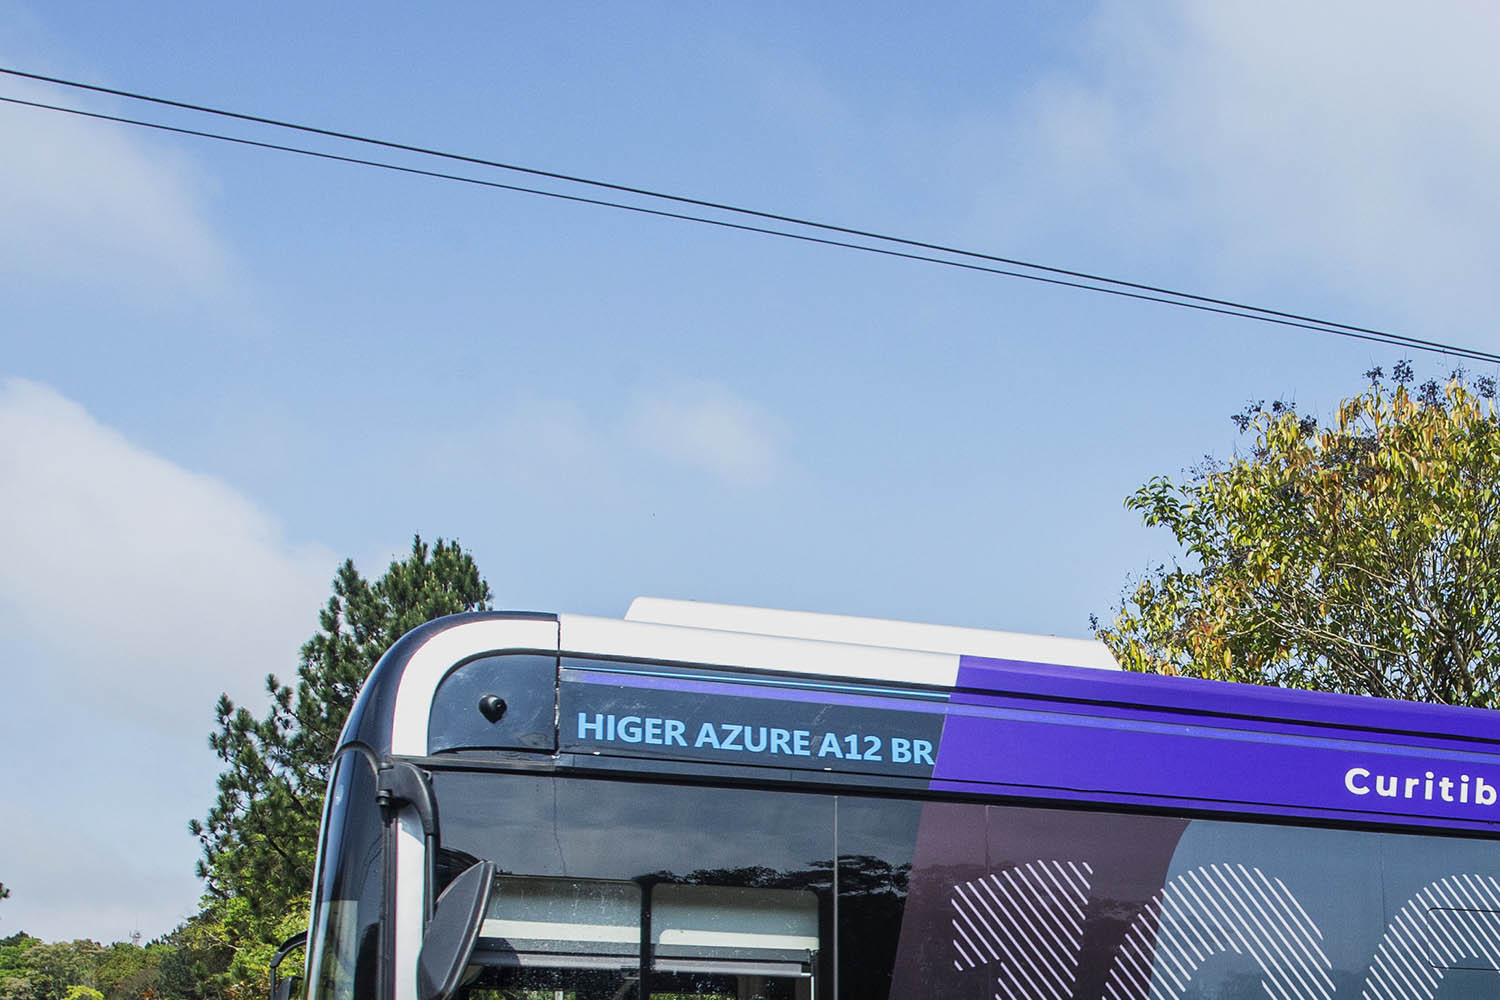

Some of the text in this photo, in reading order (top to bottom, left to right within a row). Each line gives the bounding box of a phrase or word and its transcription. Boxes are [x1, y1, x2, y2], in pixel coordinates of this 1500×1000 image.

[577, 712, 935, 766] HIGER AZURE A12 BR
